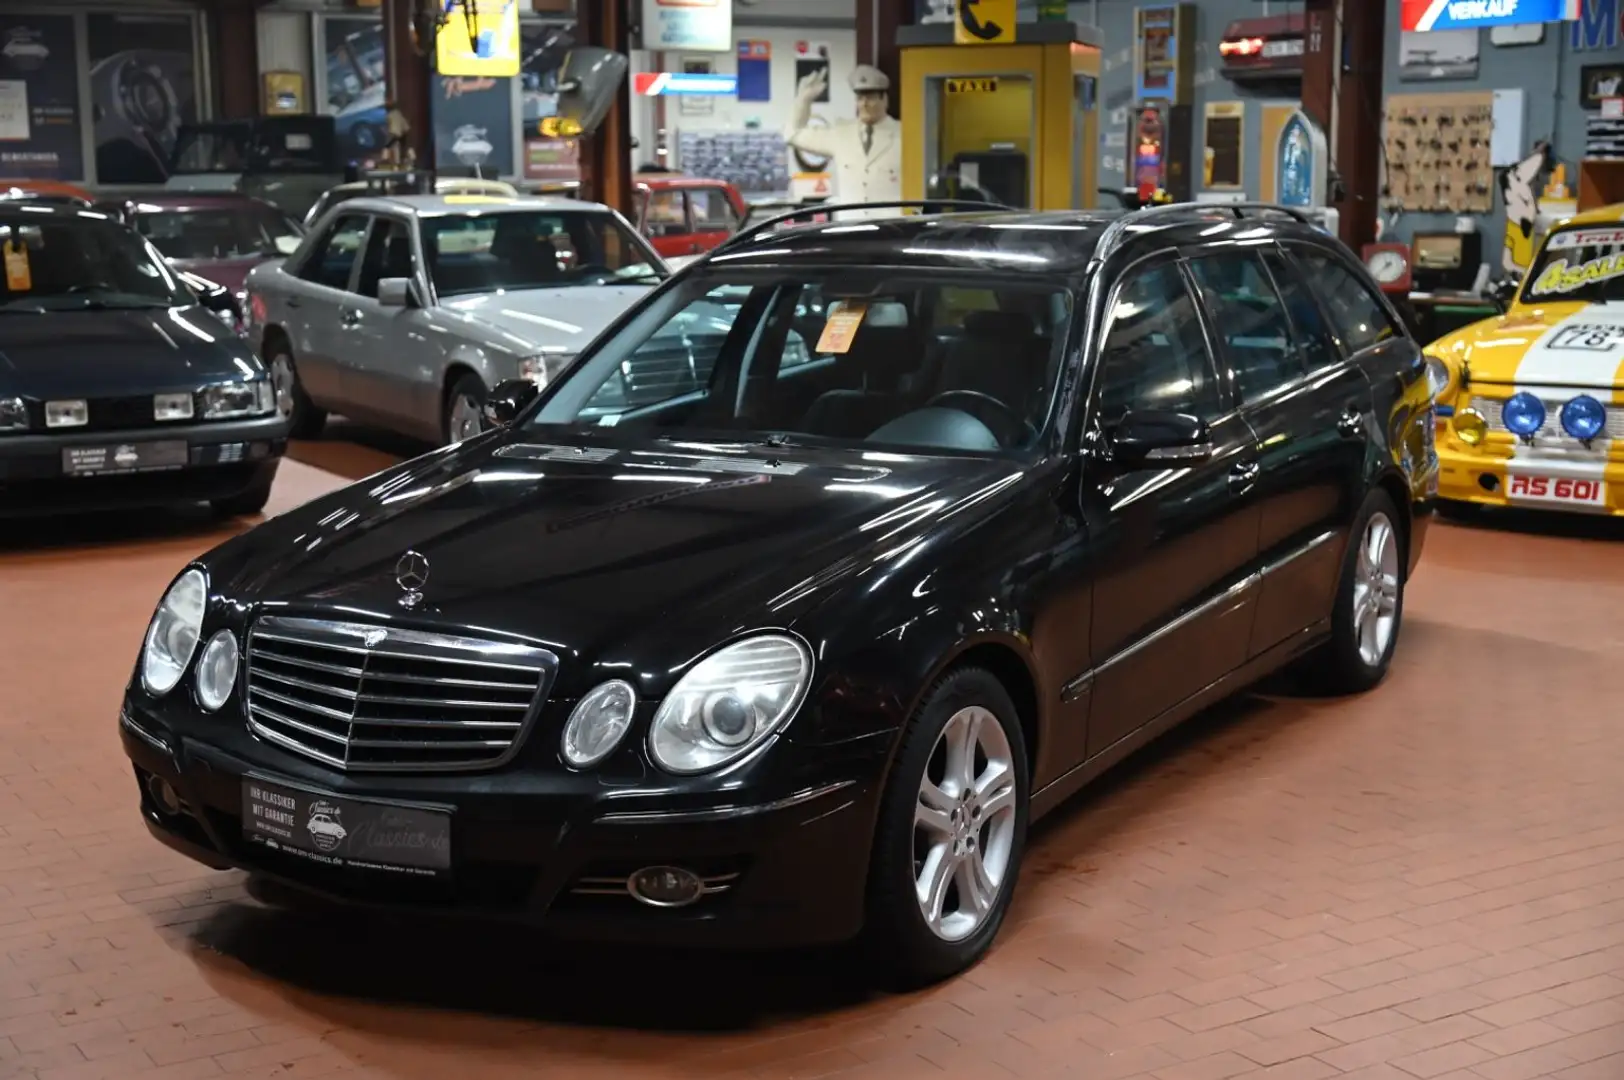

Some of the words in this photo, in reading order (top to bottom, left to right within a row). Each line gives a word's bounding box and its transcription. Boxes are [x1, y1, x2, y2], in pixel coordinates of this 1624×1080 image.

[1448, 0, 1517, 21] VERKAUF
[1565, 329, 1610, 346] 78
[1511, 474, 1549, 496] RS
[1554, 477, 1600, 502] 601
[250, 787, 260, 798] IHR
[262, 791, 295, 810] KLASSIKER
[252, 803, 263, 816] MIT
[264, 807, 295, 827] GARANTIE
